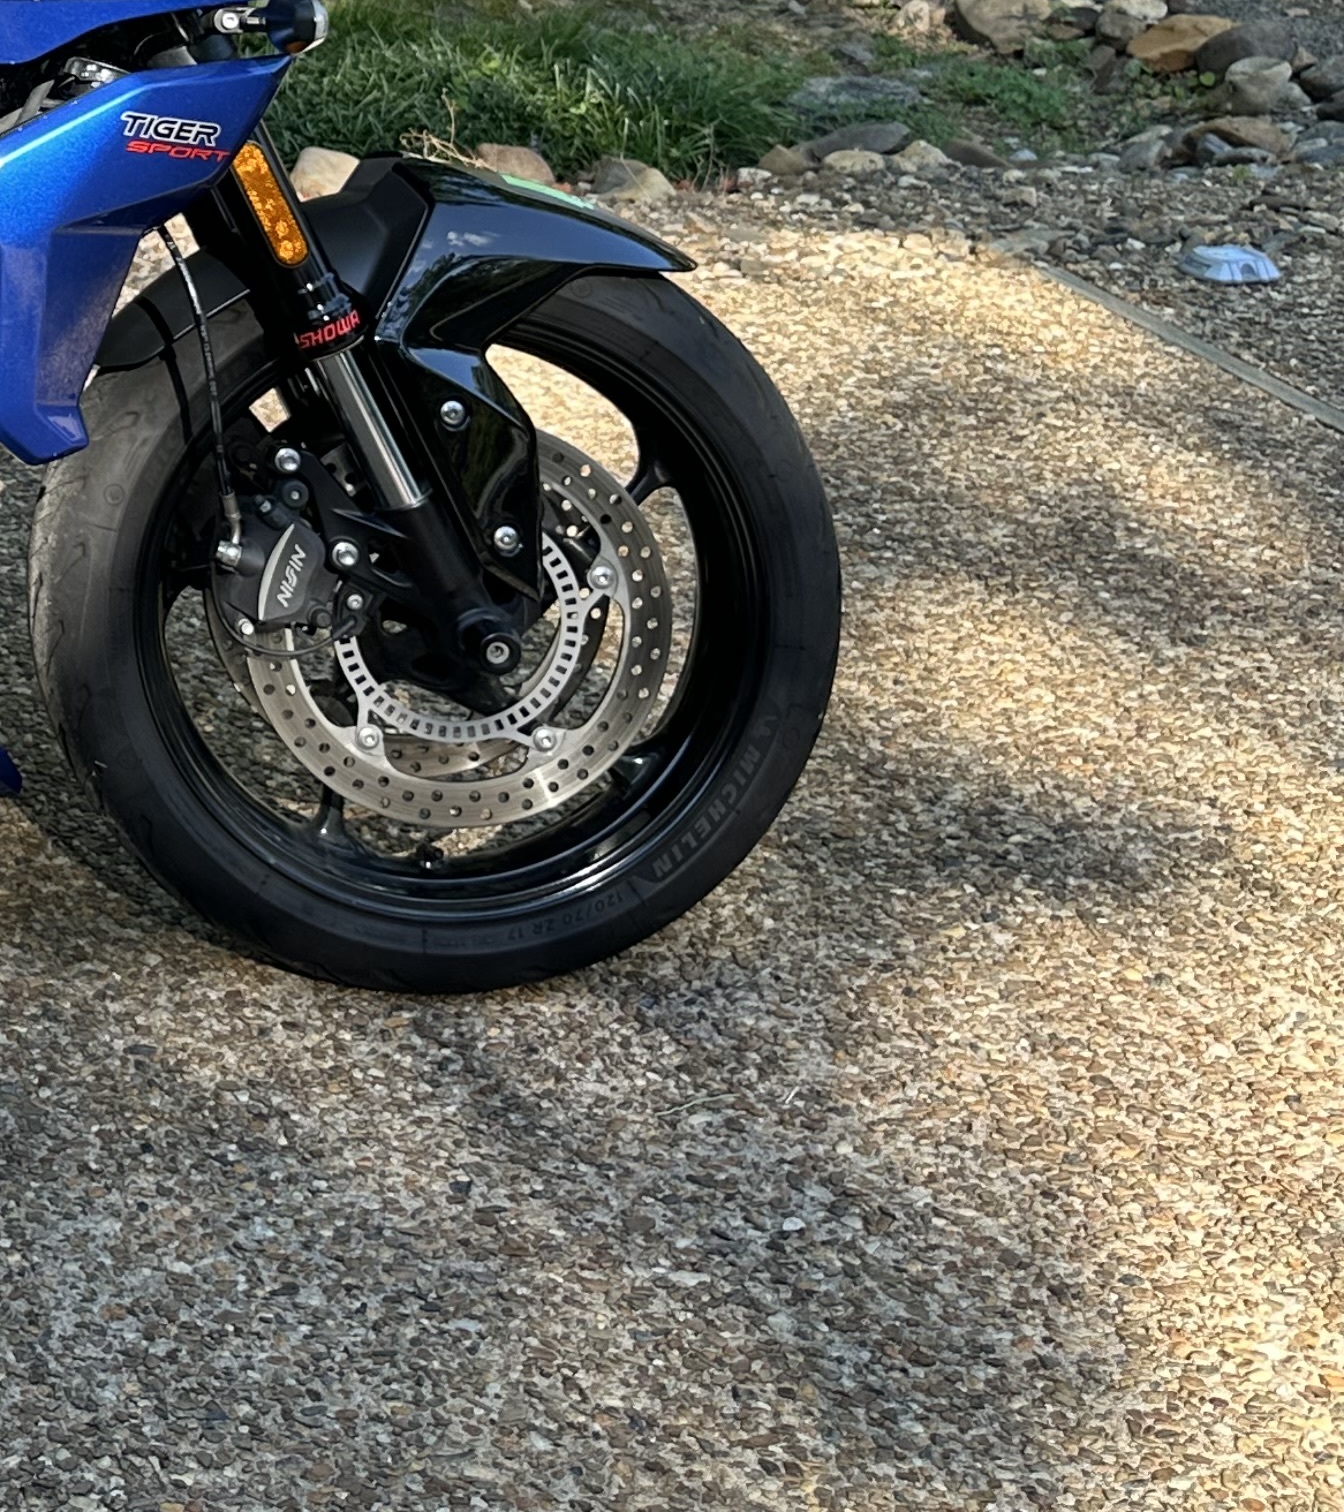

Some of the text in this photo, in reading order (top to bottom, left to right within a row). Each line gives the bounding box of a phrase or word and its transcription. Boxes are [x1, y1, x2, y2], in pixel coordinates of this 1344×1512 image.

[121, 111, 221, 147] TIGER
[126, 140, 230, 163] SPORT
[298, 309, 361, 349] SHOWA
[651, 744, 761, 878] MICHELIN
[508, 892, 624, 940] 120/70 ZR 17
